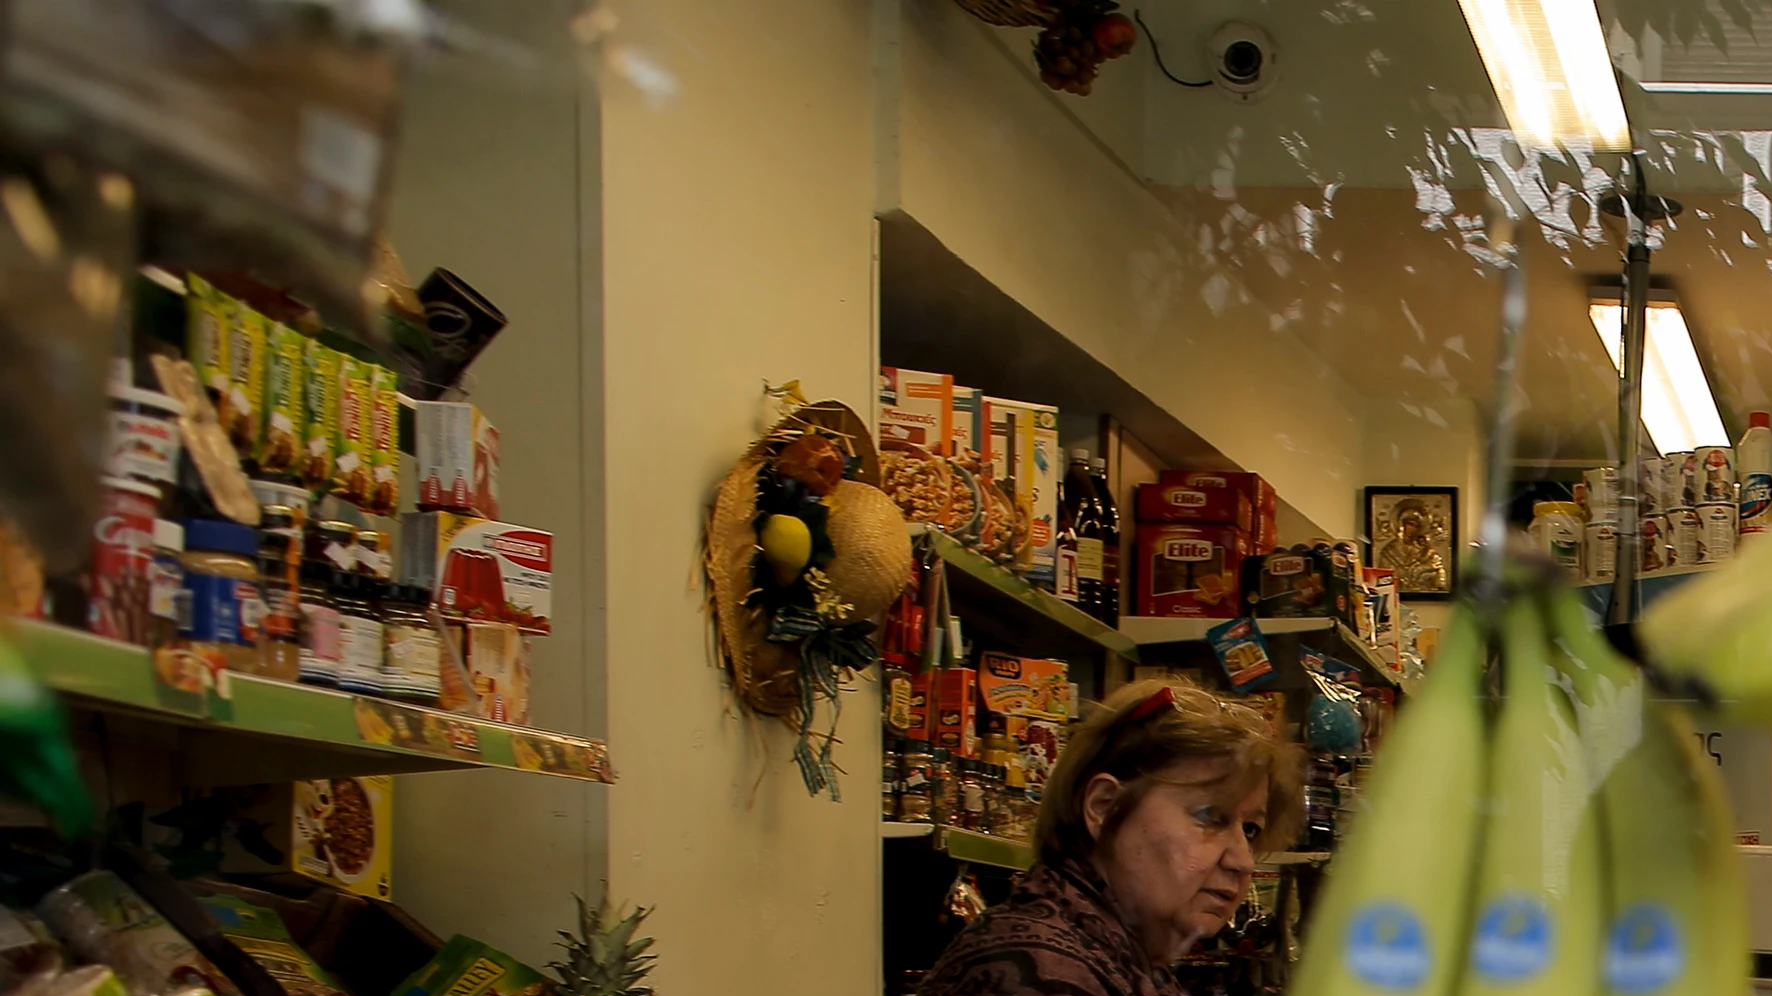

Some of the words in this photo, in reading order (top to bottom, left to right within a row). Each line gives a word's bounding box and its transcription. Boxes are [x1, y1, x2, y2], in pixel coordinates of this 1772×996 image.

[1173, 493, 1204, 505] Elite
[1167, 541, 1210, 558] Elite
[1273, 559, 1303, 572] Elite
